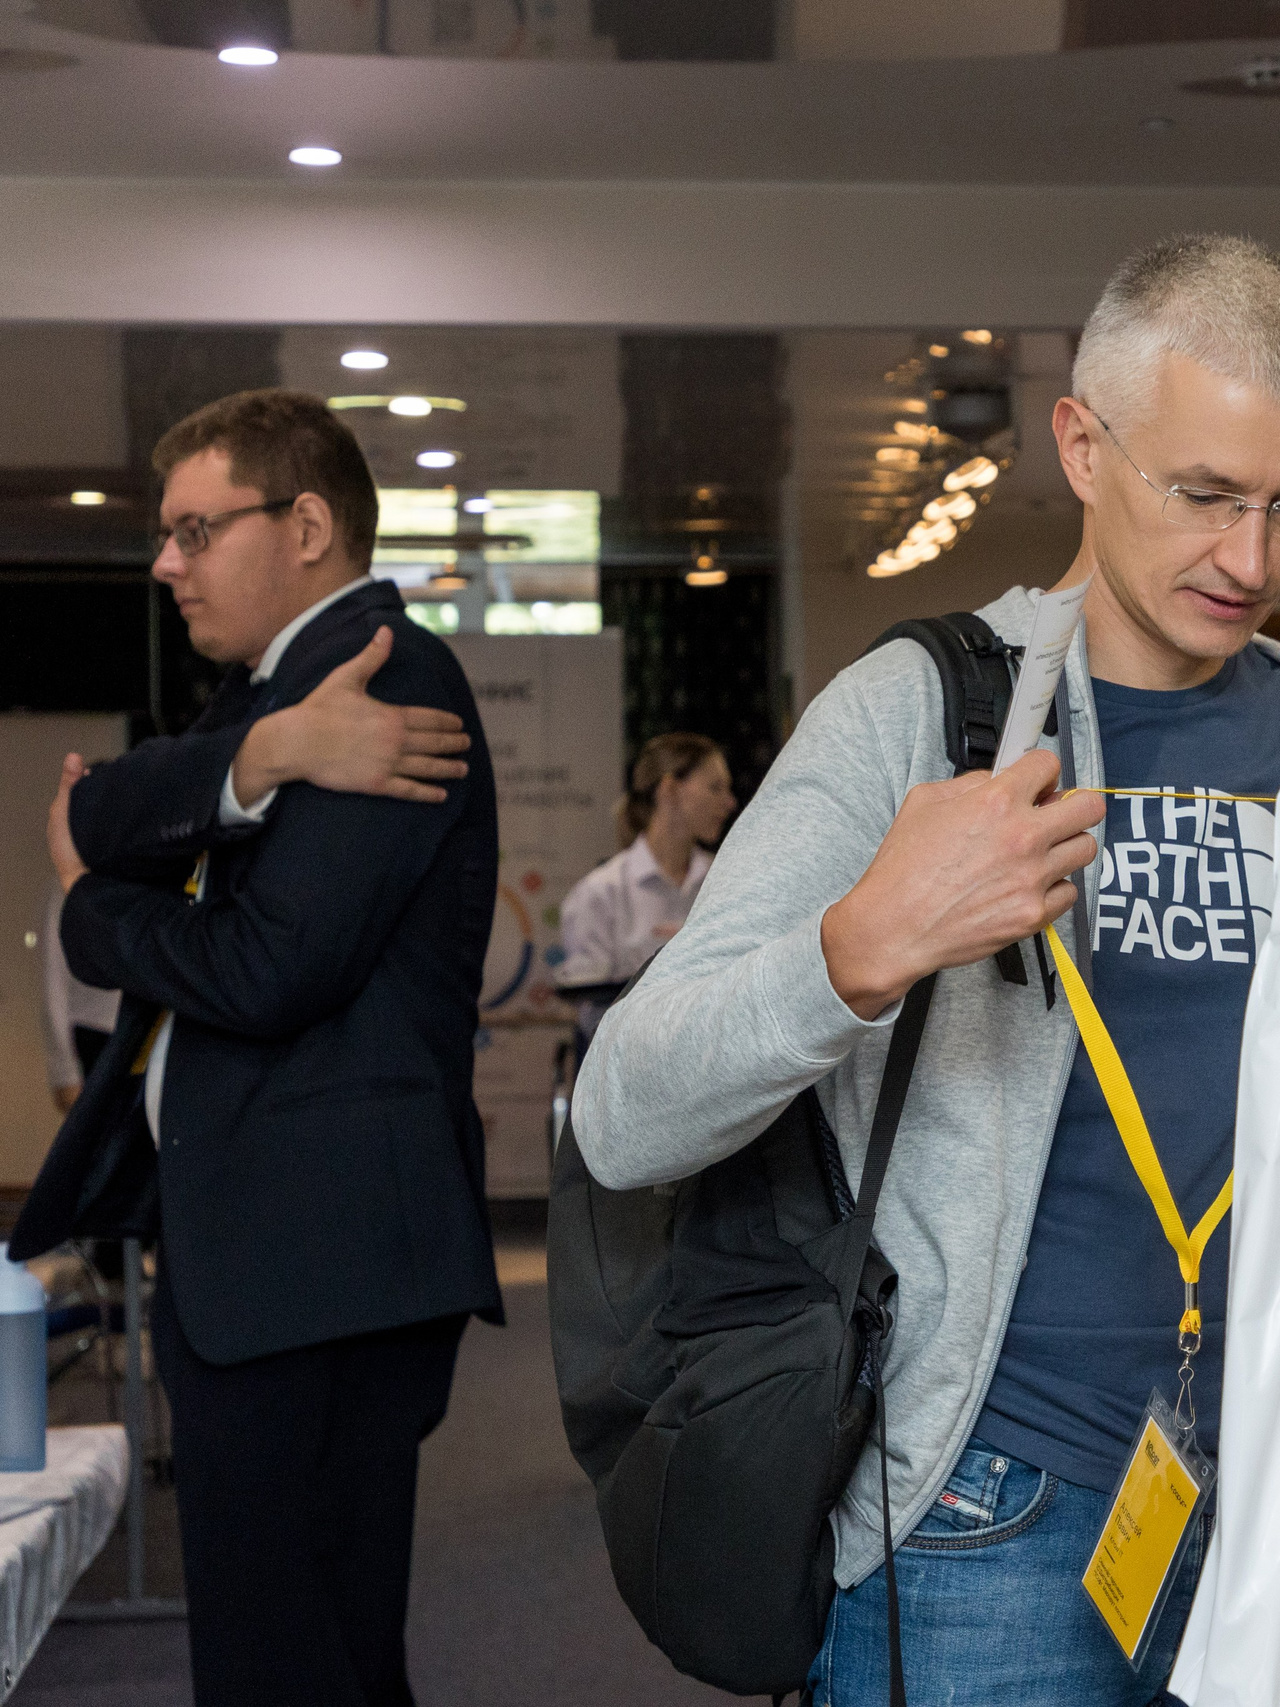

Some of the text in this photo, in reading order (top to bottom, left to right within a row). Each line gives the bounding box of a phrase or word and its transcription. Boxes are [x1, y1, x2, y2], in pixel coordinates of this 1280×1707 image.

[1114, 786, 1235, 849] THE
[1093, 895, 1249, 964] FACE
[1120, 1501, 1142, 1540] Алексей
